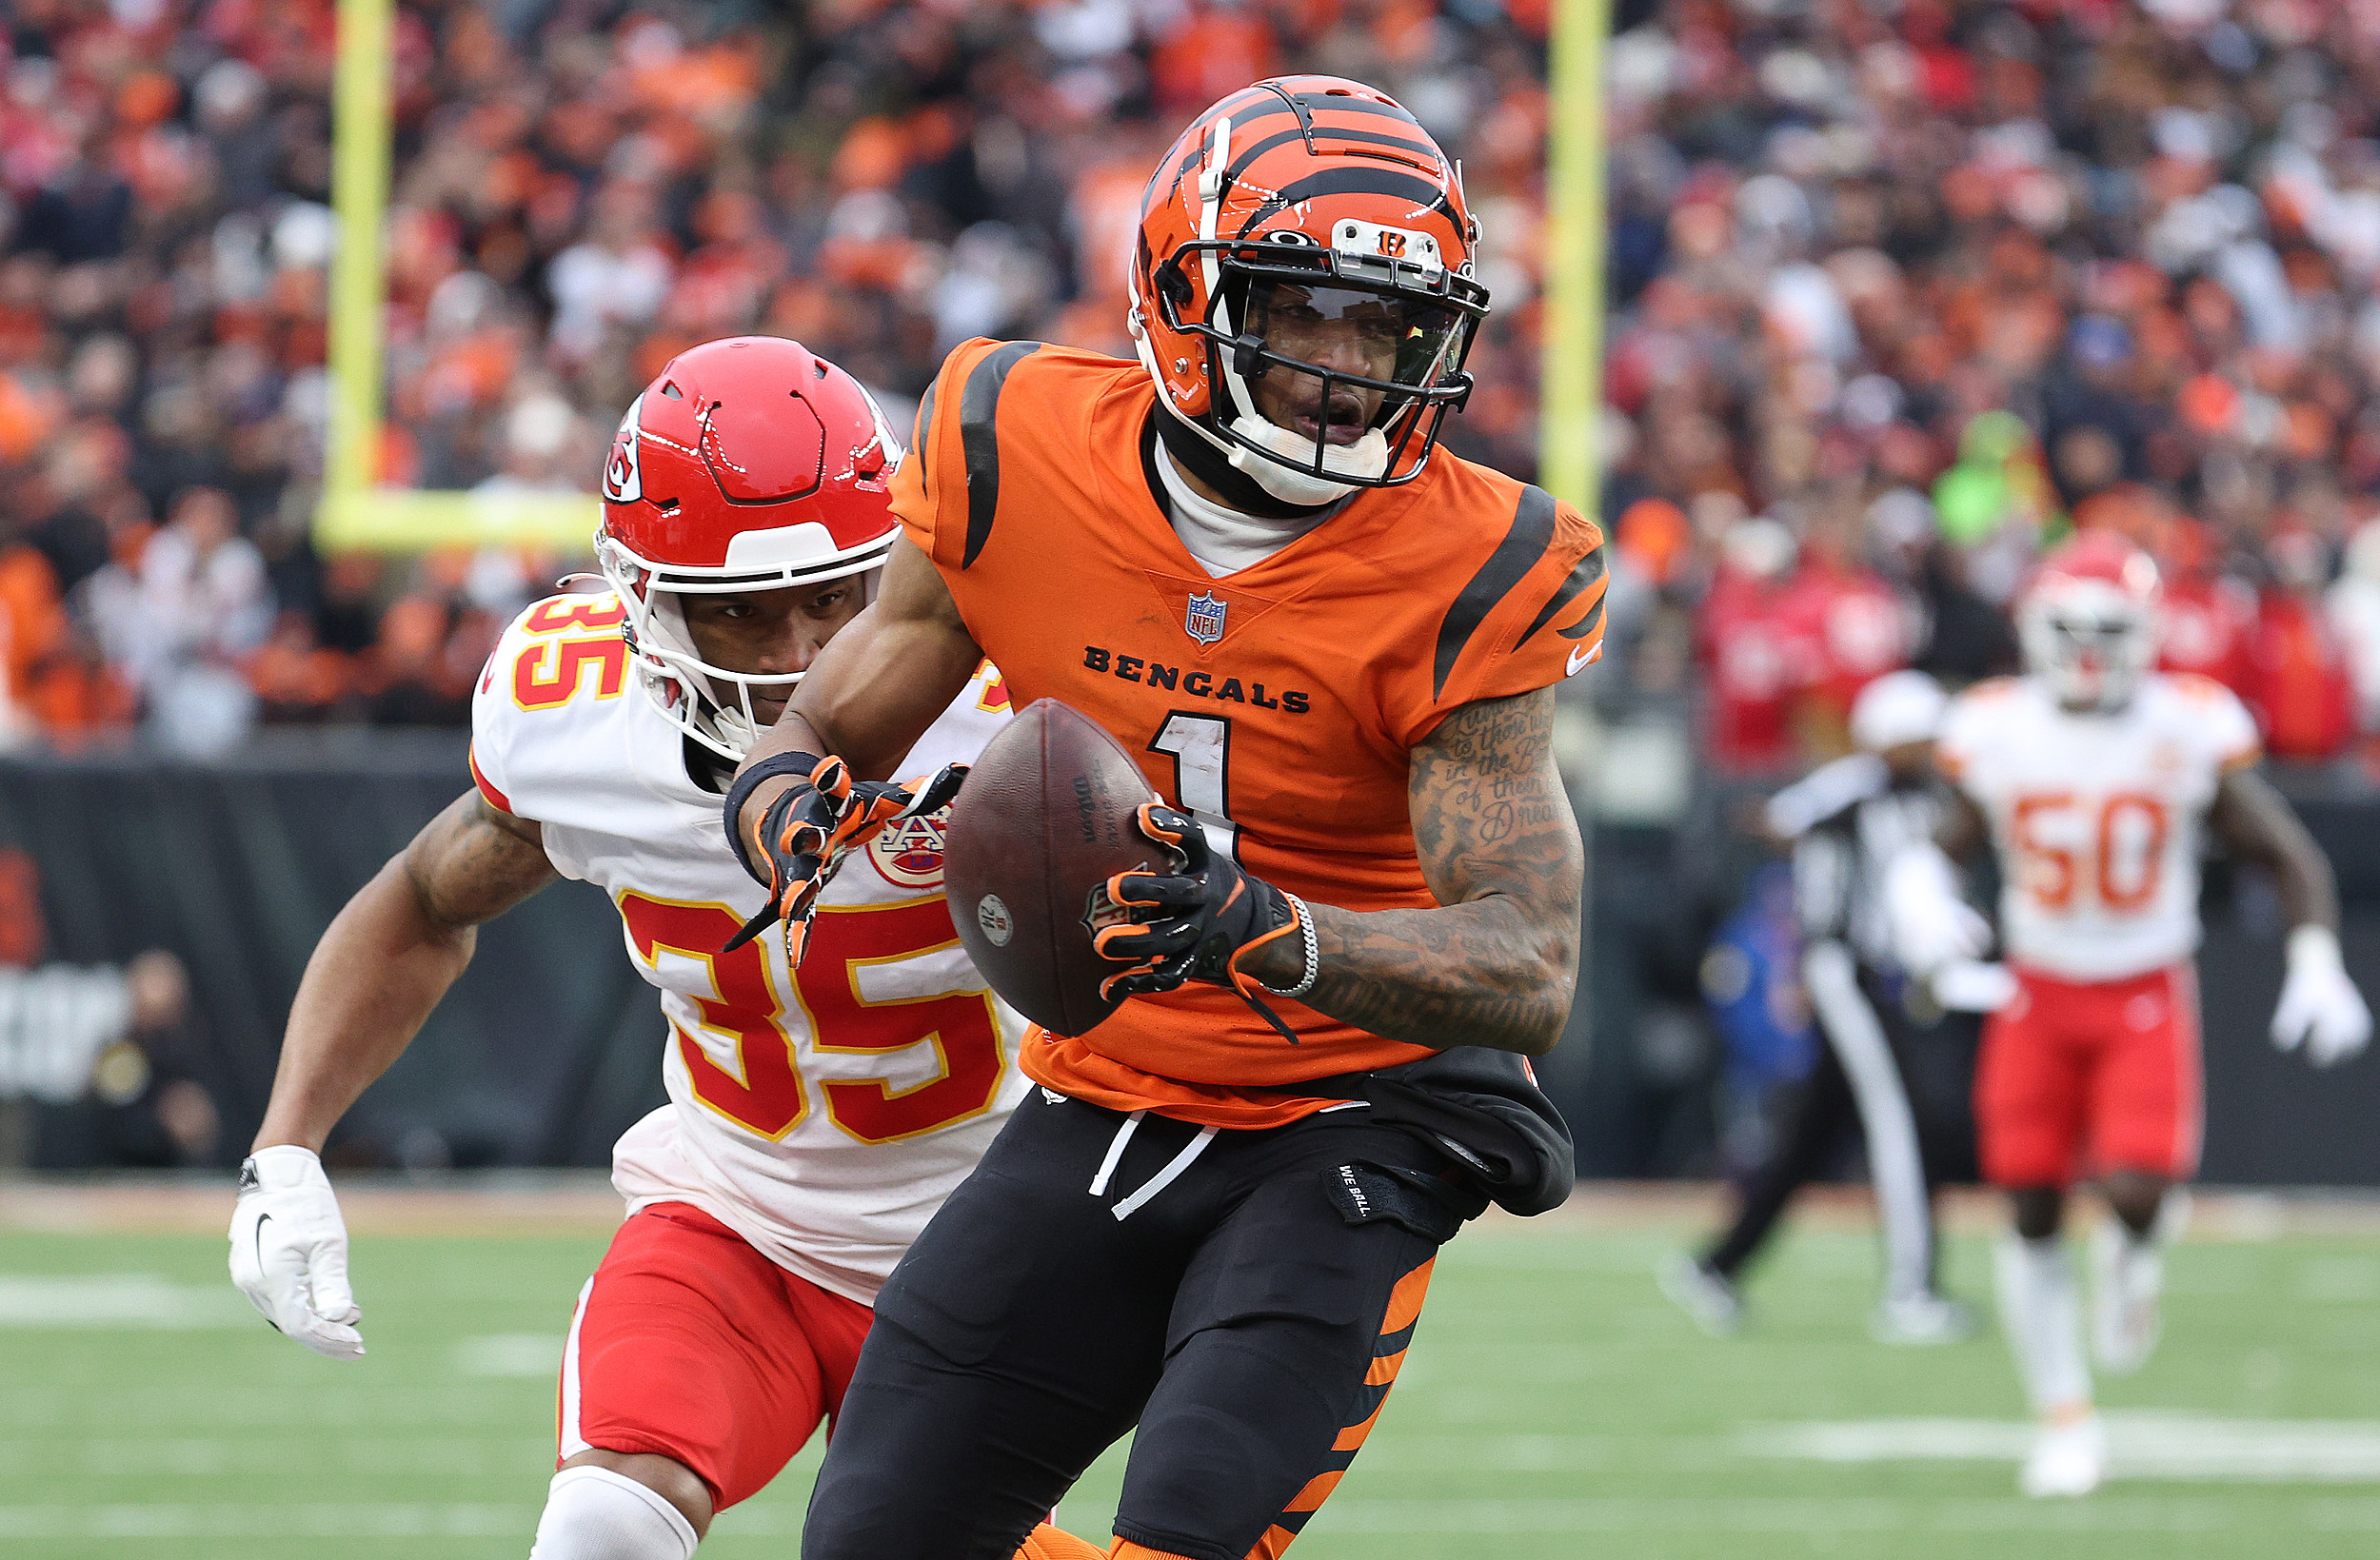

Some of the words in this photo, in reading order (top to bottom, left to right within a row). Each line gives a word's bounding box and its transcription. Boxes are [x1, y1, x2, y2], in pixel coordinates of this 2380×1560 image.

[511, 593, 632, 712] 35
[1190, 614, 1219, 637] NFL
[1083, 645, 1310, 714] BENGALS
[1145, 708, 1241, 860] 1
[1478, 747, 1511, 776] the
[1072, 774, 1097, 844] Wilson
[2011, 792, 2172, 911] 50
[615, 887, 1008, 1146] 35
[1339, 1165, 1357, 1186] WE
[1348, 1187, 1371, 1217] BALL.
